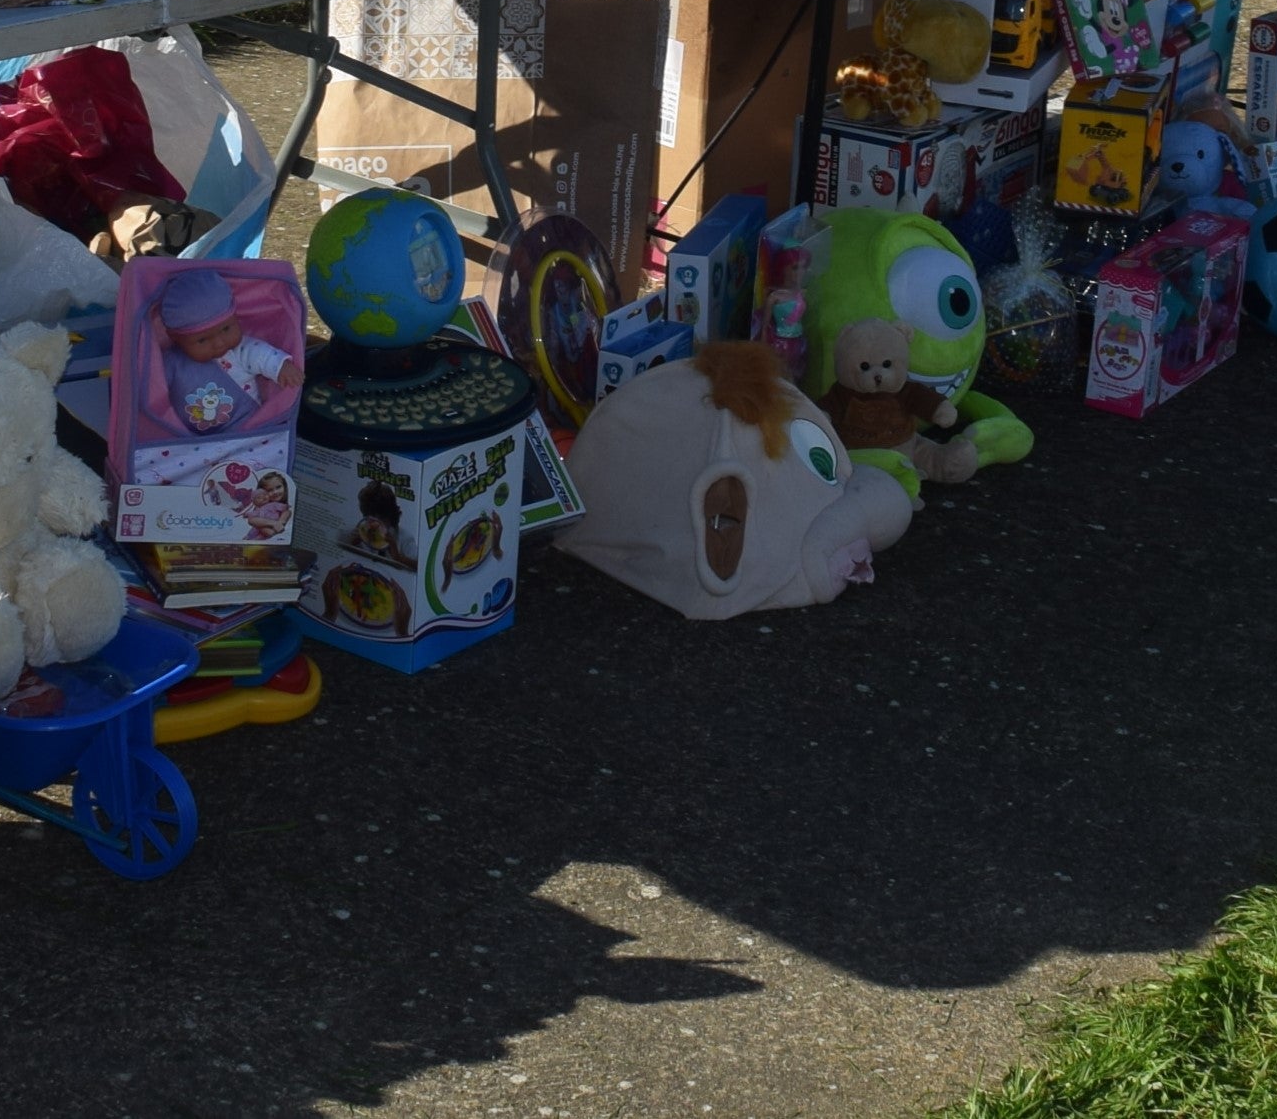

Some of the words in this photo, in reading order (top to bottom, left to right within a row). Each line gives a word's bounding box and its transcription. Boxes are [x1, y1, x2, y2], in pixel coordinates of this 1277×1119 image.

[1254, 56, 1265, 112] ESPAÑA
[1078, 121, 1127, 139] TRUCK
[318, 154, 388, 184] spaço
[615, 143, 626, 175] ONLINE
[569, 152, 580, 215] spacocasa.com
[619, 132, 639, 274] www.espacocasaonline.com
[363, 454, 388, 469] MAZE
[526, 428, 571, 504] SPEEDCARS
[434, 462, 477, 499] MAZE
[166, 513, 234, 529] colorbaby's
